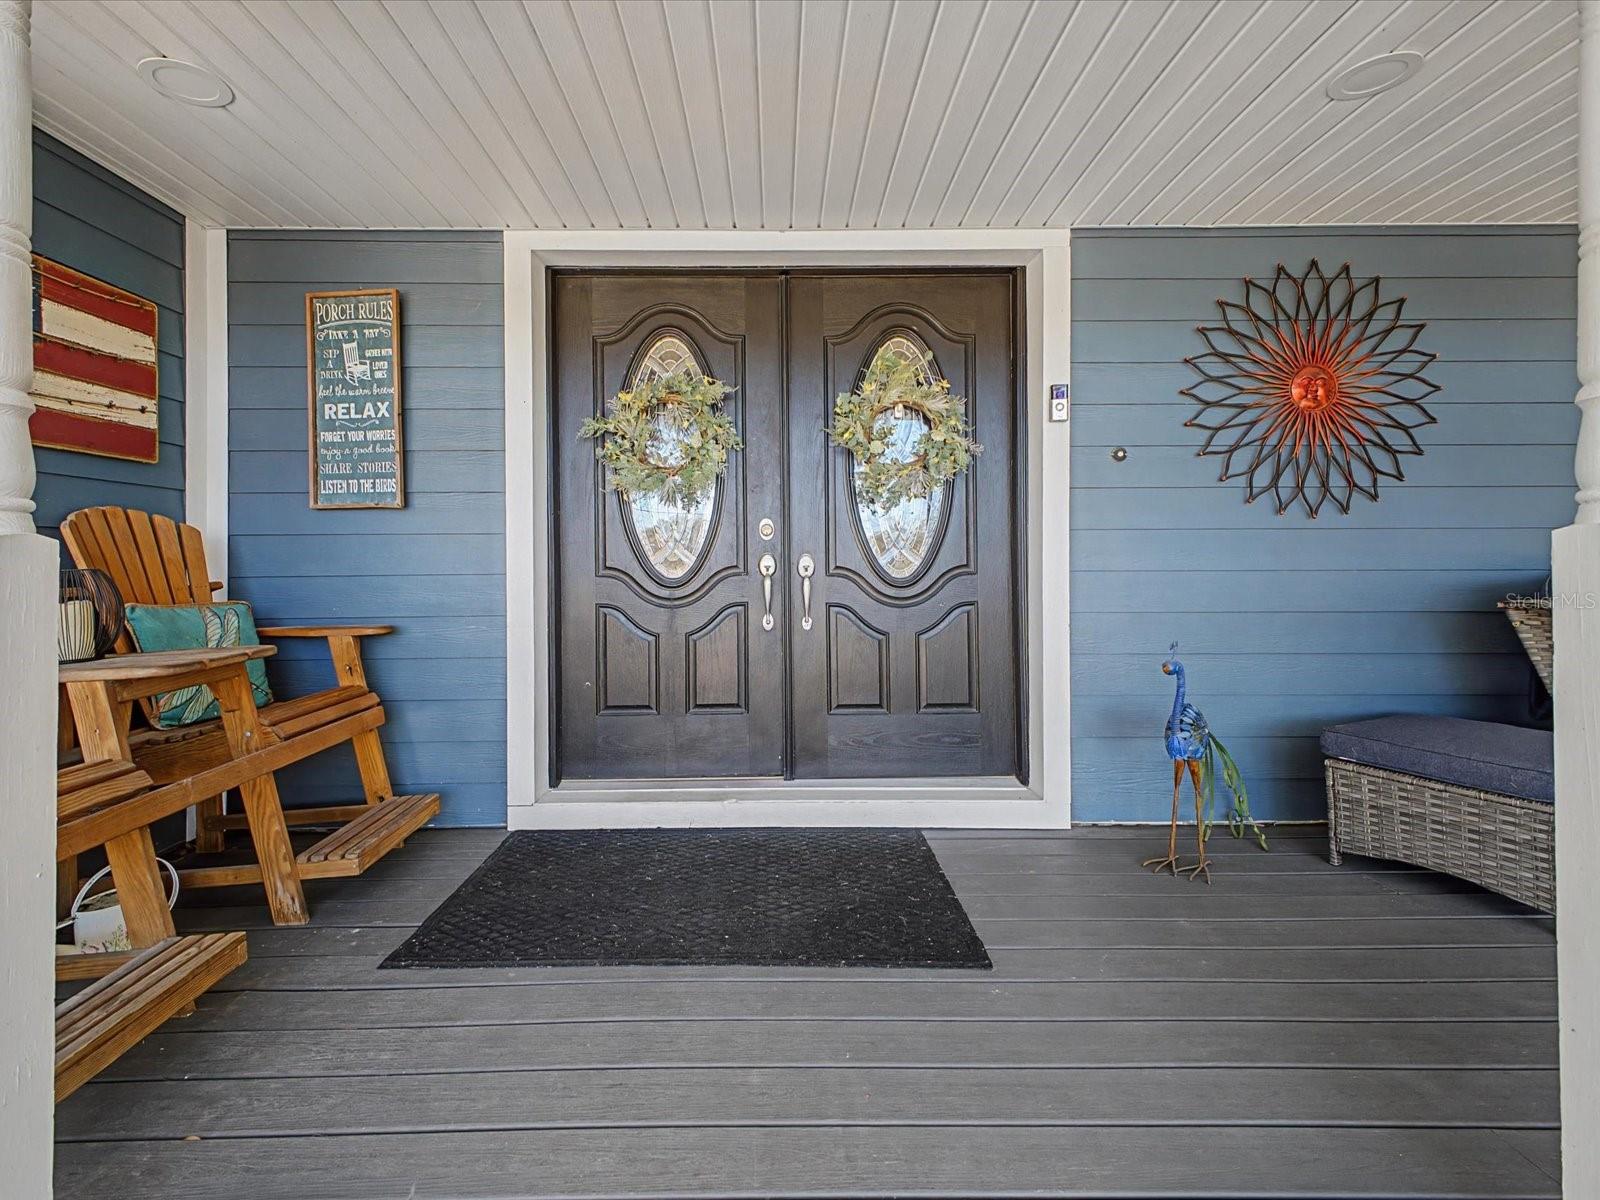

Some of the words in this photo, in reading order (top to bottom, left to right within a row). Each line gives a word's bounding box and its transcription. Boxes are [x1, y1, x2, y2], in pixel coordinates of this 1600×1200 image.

[316, 303, 354, 324] PORCH
[359, 300, 393, 320] RULES
[353, 329, 359, 339] A
[323, 349, 339, 359] SIP
[326, 360, 333, 369] A
[320, 370, 343, 379] DRINK
[335, 383, 347, 396] the
[324, 401, 390, 419] RELAX
[320, 431, 346, 442] FORGET
[347, 431, 365, 442] YOUR
[366, 429, 395, 441] WORRIES
[352, 444, 373, 459] good
[375, 442, 396, 454] book
[320, 462, 352, 474] SHARE
[357, 461, 397, 473] STORIES
[320, 479, 347, 494] LISTEN
[348, 480, 358, 493] TO
[360, 479, 374, 493] THE
[375, 478, 396, 493] BIRDS
